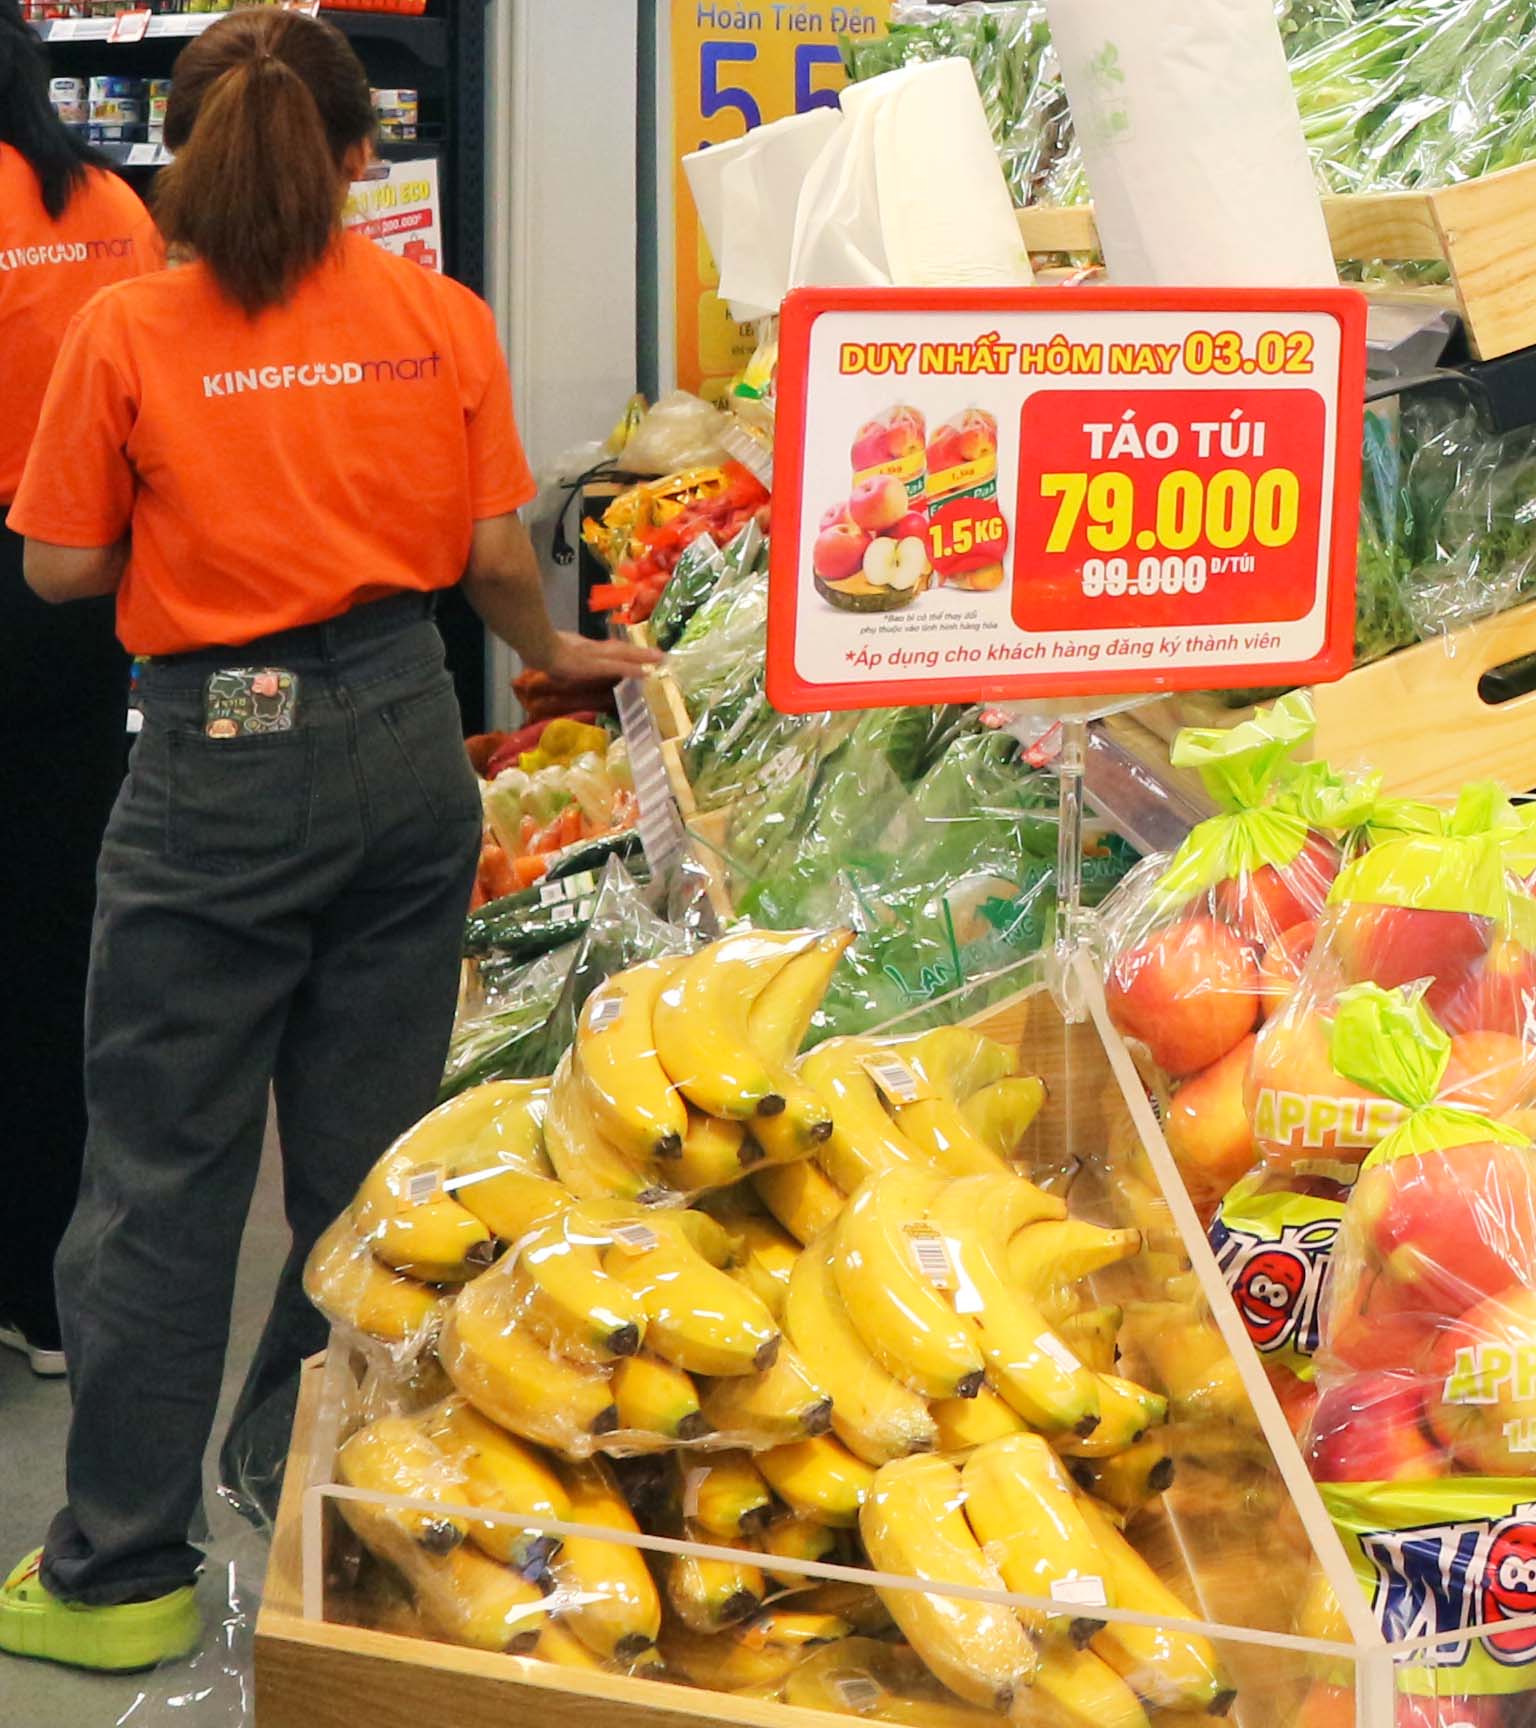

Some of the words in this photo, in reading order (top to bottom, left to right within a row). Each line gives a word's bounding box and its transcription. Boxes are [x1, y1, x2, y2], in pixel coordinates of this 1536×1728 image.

[696, 3, 762, 32] Hoàn
[771, 1, 822, 33] Tiền
[831, 3, 876, 35] Đến
[839, 342, 914, 375] DUY
[920, 331, 1016, 375] NHẤT
[1021, 334, 1102, 374] HÔM
[1109, 342, 1180, 374] NAY
[1183, 331, 1313, 374] 03.02
[1083, 410, 1178, 460] TÁO
[1191, 408, 1265, 458] TÚI
[1039, 466, 1299, 553] 79.000
[1081, 556, 1206, 598] 99.000
[887, 648, 939, 668] dụng
[944, 645, 982, 663] cho
[986, 642, 1046, 662] khách
[1051, 639, 1100, 661] hàng
[1105, 636, 1154, 660] đăng
[1158, 635, 1181, 656] ký
[1186, 633, 1239, 653] thành
[1244, 631, 1281, 650] viên
